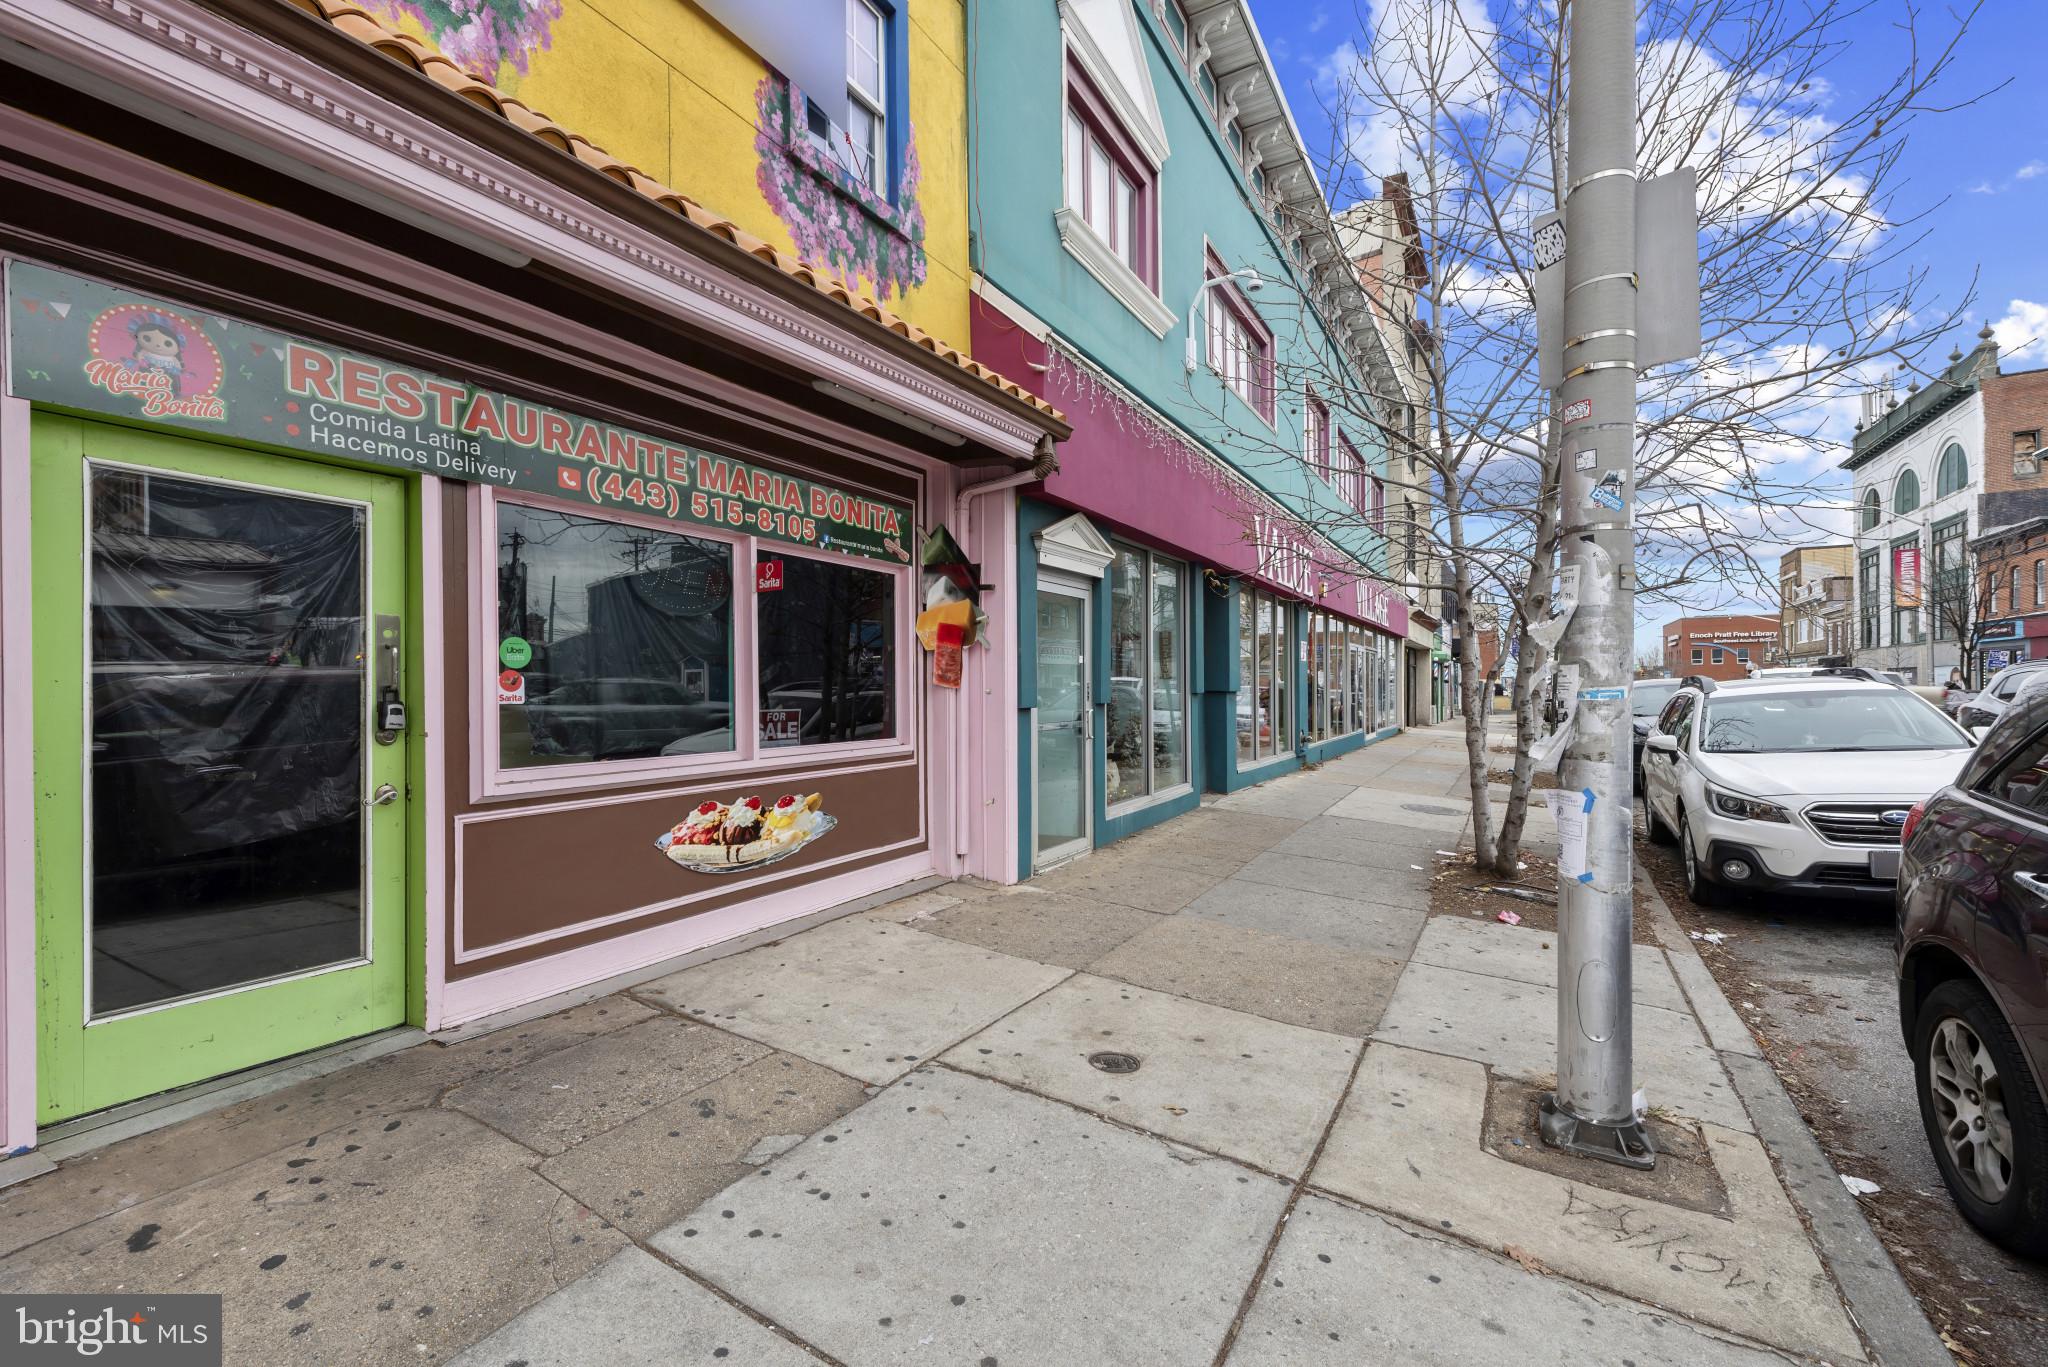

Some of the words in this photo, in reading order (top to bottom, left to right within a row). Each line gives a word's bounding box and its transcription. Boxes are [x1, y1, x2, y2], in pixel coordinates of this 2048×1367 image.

[142, 389, 224, 419] Bonita
[287, 342, 688, 485] RESTAURANTE
[697, 455, 804, 513] MARIA
[810, 486, 900, 536] BONITA
[309, 402, 406, 440] Comida
[415, 425, 481, 456] Latina
[310, 424, 428, 464] Hacemos
[436, 450, 517, 485] Delivery
[587, 466, 680, 518] (443)
[691, 492, 816, 541] 515-8105
[1254, 515, 1314, 598] VALUE
[640, 565, 725, 600] OPEN
[758, 577, 780, 588] Sarita
[1356, 578, 1390, 628] VILLAGE
[506, 646, 524, 654] Uber
[1750, 630, 1778, 638] Library
[498, 693, 523, 702] Sarita
[767, 712, 786, 721] FOR
